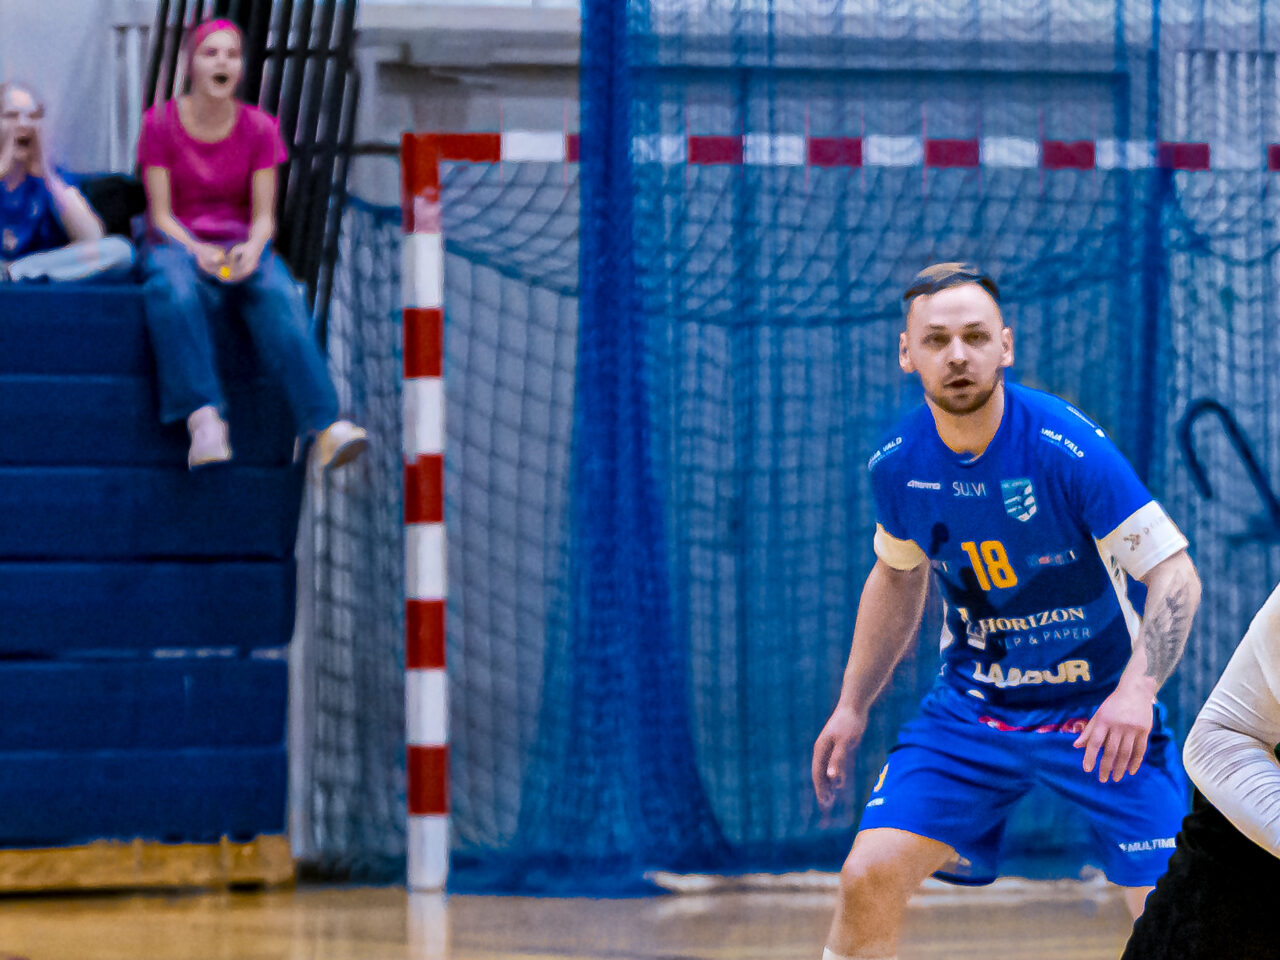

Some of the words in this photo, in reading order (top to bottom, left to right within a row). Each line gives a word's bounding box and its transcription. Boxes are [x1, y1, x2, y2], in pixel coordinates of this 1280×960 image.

[961, 540, 1018, 591] 18
[980, 607, 1085, 633] HORIZON
[1043, 627, 1091, 641] PAPER
